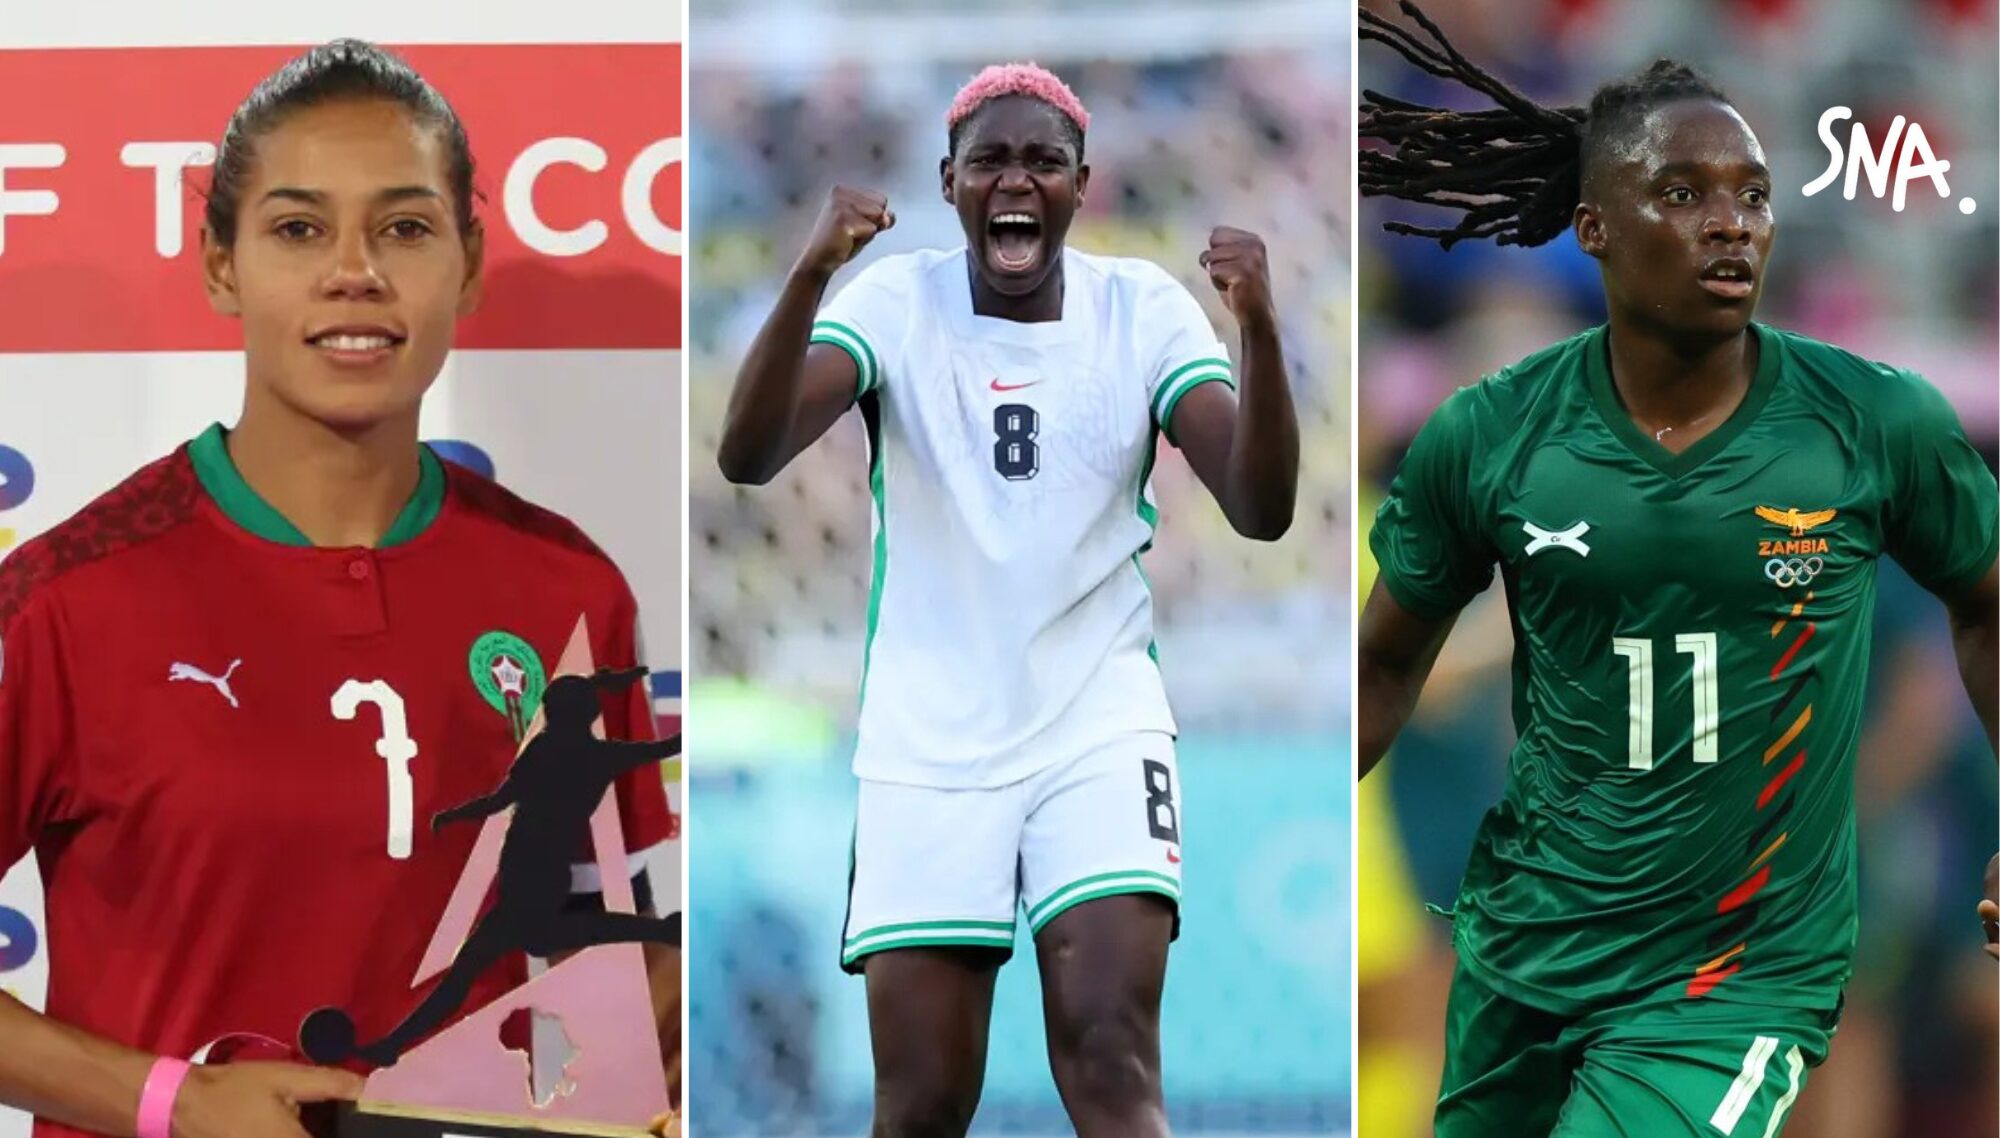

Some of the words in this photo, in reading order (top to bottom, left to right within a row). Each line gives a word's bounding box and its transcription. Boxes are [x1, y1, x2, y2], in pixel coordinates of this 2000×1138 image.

[993, 404, 1040, 481] 8
[1758, 538, 1829, 556] ZAMBIA
[1613, 632, 1718, 770] 11
[330, 679, 418, 859] 7
[1142, 758, 1180, 846] 8
[1708, 1035, 1804, 1138] 11
